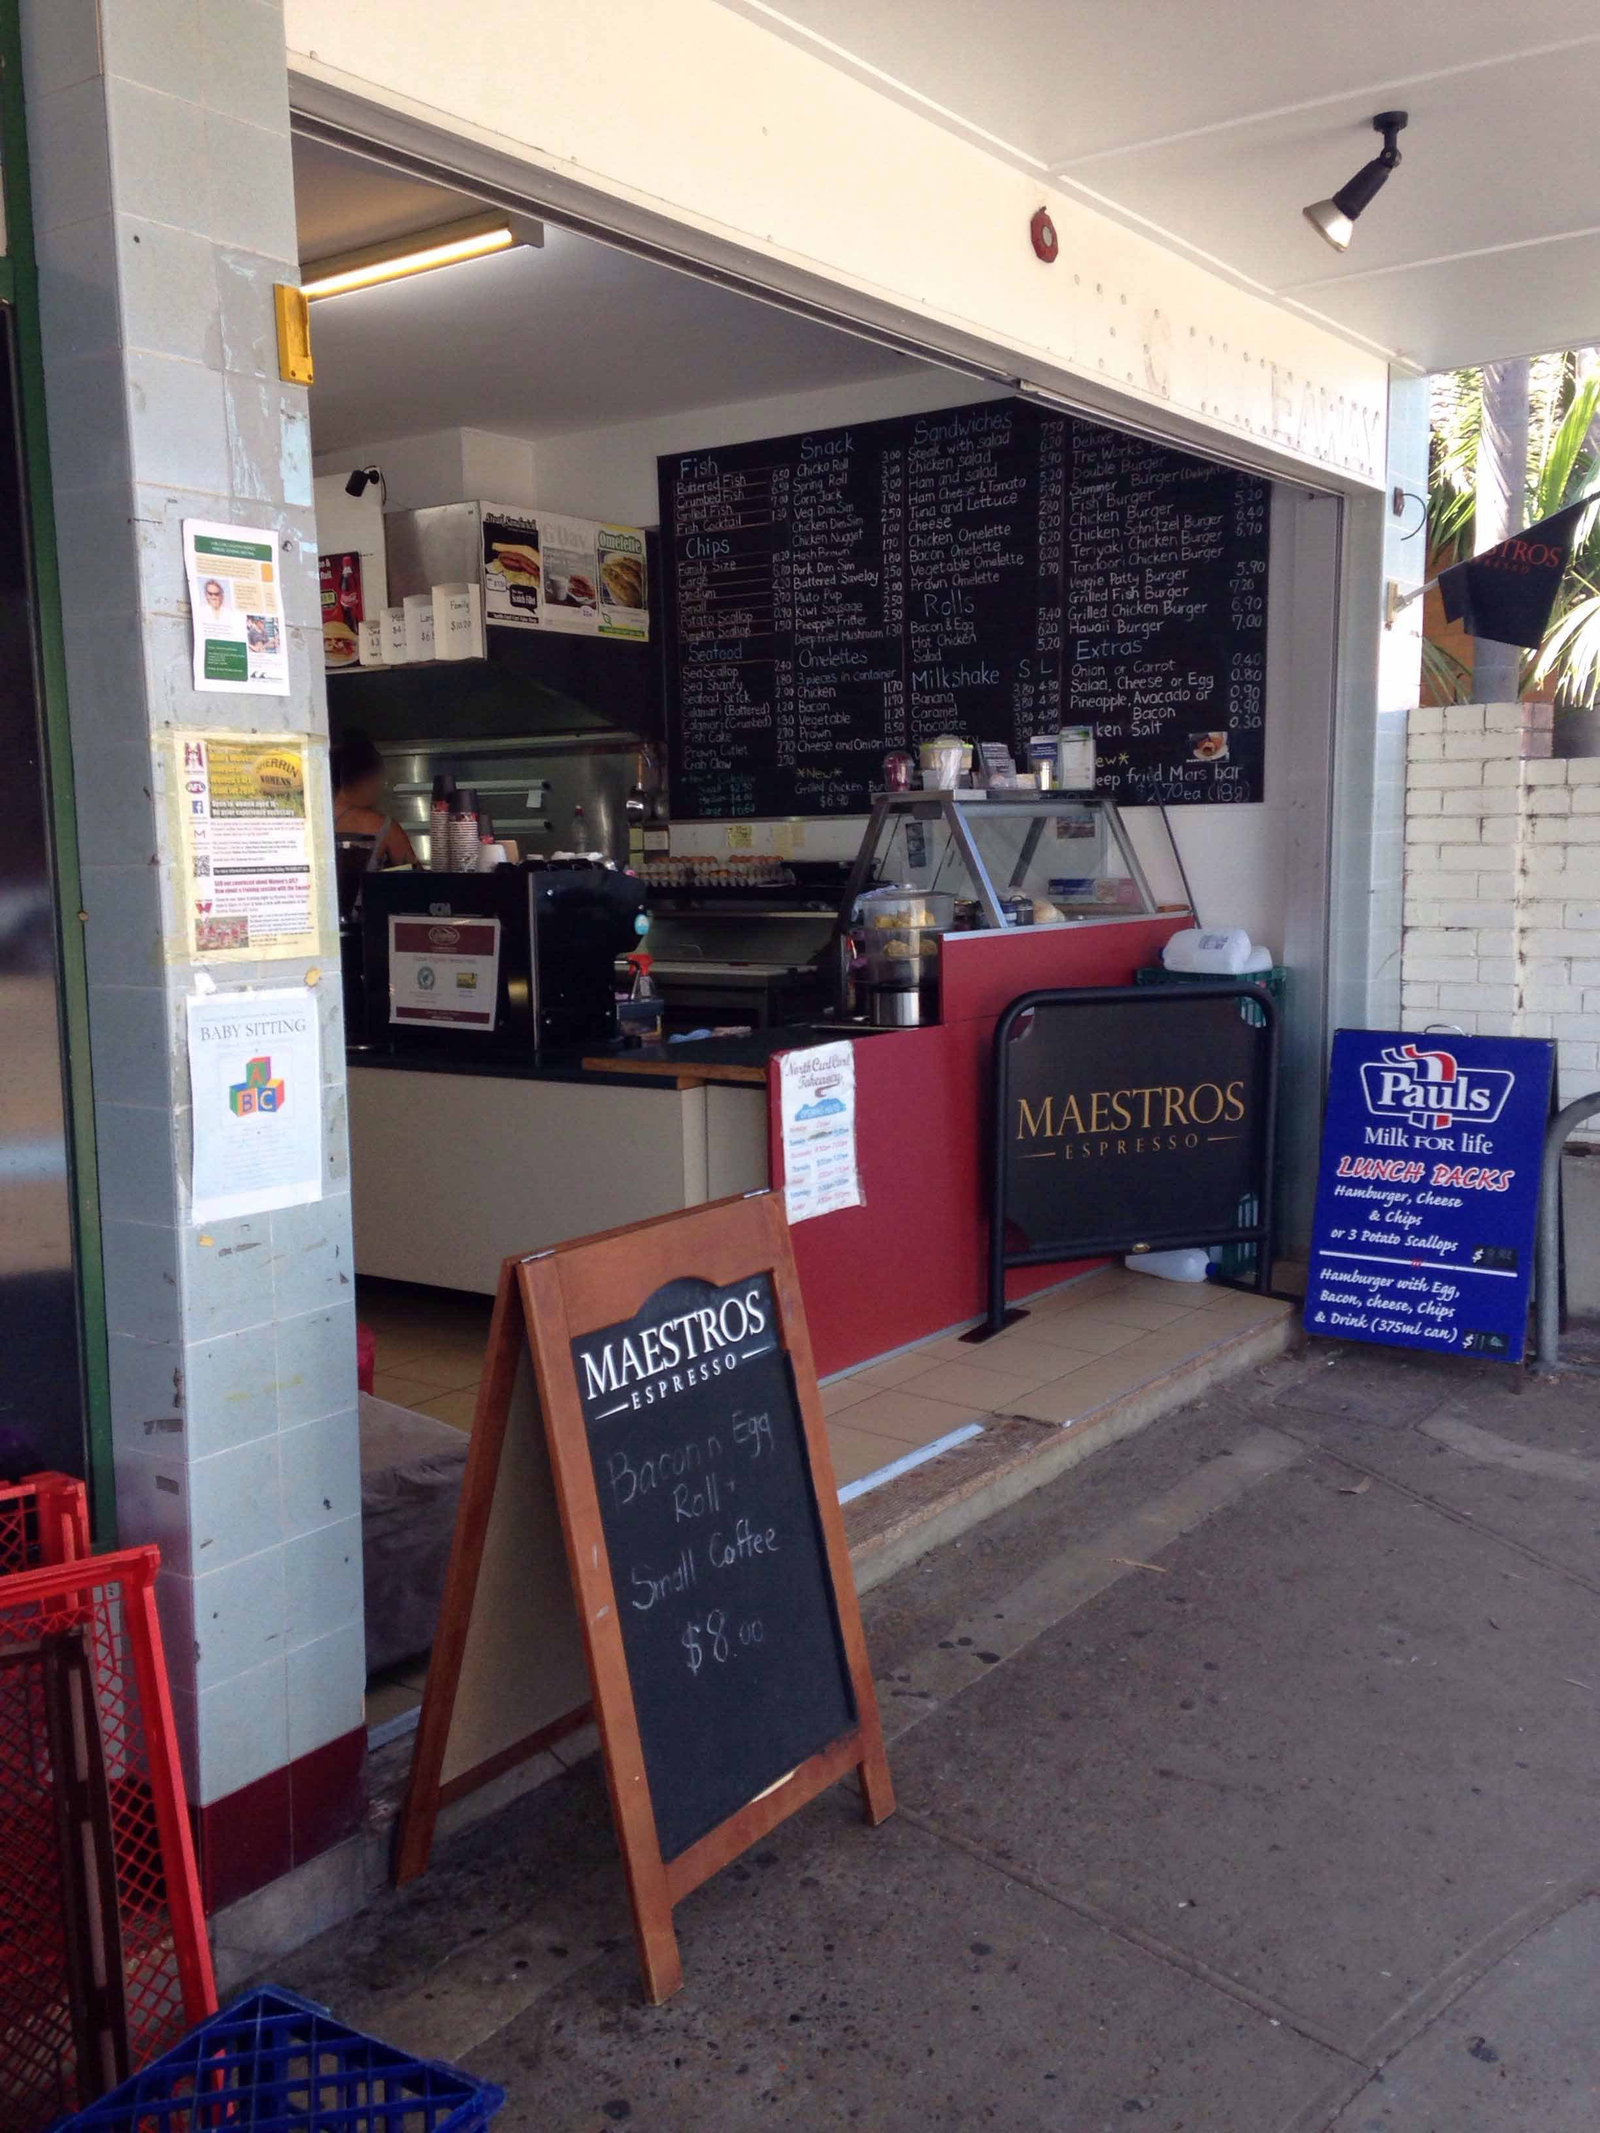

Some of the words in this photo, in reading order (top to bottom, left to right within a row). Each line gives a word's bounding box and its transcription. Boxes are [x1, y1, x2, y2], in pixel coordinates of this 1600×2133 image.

[913, 408, 1014, 445] Sandwiches
[801, 432, 855, 460] Snack
[907, 440, 941, 461] Steak
[947, 439, 974, 454] with
[977, 432, 1010, 449] salad
[1072, 450, 1097, 464] The
[1101, 441, 1144, 460] Works
[680, 456, 719, 479] Fish
[908, 457, 954, 474] Chicken
[957, 450, 991, 467] salad
[1072, 462, 1115, 480] Double
[1121, 456, 1166, 473] Burger
[829, 472, 848, 487] Roll
[909, 476, 934, 491] Ham
[938, 469, 960, 486] and
[965, 462, 998, 482] salad
[1070, 480, 1118, 497] Summer
[1131, 469, 1182, 489] Burger
[793, 493, 816, 506] Corn
[817, 489, 842, 502] Jack
[909, 492, 935, 505] Ham
[939, 485, 975, 500] Cheese
[989, 475, 1026, 492] Tomato
[1071, 497, 1100, 513] Fish
[1107, 490, 1156, 508] Burger
[909, 506, 936, 519] Tuna
[941, 499, 962, 513] and
[967, 491, 1017, 511] Lettuce
[1069, 510, 1119, 526] Chicken
[1127, 503, 1174, 523] Burger
[909, 517, 952, 532] Cheese
[909, 532, 953, 547] Chicken
[958, 524, 1012, 542] Omelette
[1069, 527, 1120, 542] Chicken
[1124, 515, 1180, 536] Schnitzel
[1184, 514, 1224, 531] Burger
[686, 537, 730, 559] Chips
[909, 550, 945, 562] Bacon
[951, 541, 1002, 557] Omelette
[1071, 541, 1124, 560] Teriyaki
[1128, 533, 1178, 551] Chicken
[1181, 530, 1222, 548] Burger
[911, 558, 970, 580] Vegetable
[974, 552, 1024, 569] Omelette
[1070, 556, 1126, 574] Tandoori
[1128, 550, 1178, 567] Chicken
[1181, 547, 1225, 564] Burger
[841, 568, 879, 587] Saveloy
[911, 578, 948, 591] Prawn
[952, 572, 1000, 586] Omelette
[1070, 575, 1105, 594] Veggie
[1109, 571, 1140, 589] Patty
[1145, 568, 1189, 587] Burger
[1236, 561, 1265, 576] 5.90
[824, 589, 842, 604] Pup
[924, 589, 975, 617] Rolls
[1068, 590, 1108, 604] Grilled
[1112, 586, 1139, 600] Fish
[1144, 585, 1190, 604] Burger
[1068, 604, 1107, 621] Grilled
[1111, 601, 1159, 618] Chicken
[1163, 599, 1208, 622] Burger
[1231, 596, 1262, 612] 6.90
[911, 621, 943, 634] Bacon
[954, 617, 974, 631] Egg
[1069, 619, 1110, 635] Hawaii
[1117, 618, 1165, 640] Burger
[1232, 615, 1262, 631] 7.00
[688, 640, 742, 662] Seafood
[912, 636, 932, 649] Hot
[937, 633, 977, 647] Chicken
[1076, 639, 1143, 661] Extras
[800, 646, 868, 668] Omelettes
[1071, 663, 1106, 677] Onion
[1114, 665, 1126, 674] or
[1133, 659, 1177, 674] Carrot
[1232, 652, 1261, 666] 0.40
[841, 672, 850, 681] in
[853, 669, 896, 681] container
[912, 660, 1000, 691] Milkshake
[1019, 659, 1030, 678] S
[1040, 658, 1053, 674] L
[1070, 679, 1111, 693] Salad,
[1117, 674, 1163, 690] Cheese
[1170, 677, 1183, 687] or
[1187, 672, 1215, 690] Egg
[1231, 668, 1262, 681] 0.80
[799, 700, 830, 713] Bacon
[911, 692, 954, 705] Banana
[1070, 694, 1131, 713] Pineapple,
[1133, 690, 1190, 705] Avocado
[1196, 689, 1211, 701] or
[1230, 685, 1260, 699] 0.90
[911, 703, 957, 719] Caramel
[1132, 706, 1176, 721] Bacon
[1229, 701, 1260, 714] 0.90
[799, 727, 831, 739] Prawn
[911, 719, 967, 733] Chocolate
[1131, 721, 1163, 737] Salt
[1229, 715, 1262, 729] 0.30
[797, 741, 833, 753] Cheese
[854, 738, 883, 751] Onion
[200, 1024, 242, 1042] BABY
[246, 1018, 307, 1038] SITTING
[251, 1065, 263, 1083] A
[242, 1093, 253, 1113] B
[259, 1091, 273, 1110] C
[1377, 1071, 1491, 1112] Pauls
[1016, 1080, 1245, 1140] MAESTROS
[1065, 1133, 1198, 1160] ESPRESSO
[1364, 1127, 1410, 1147] Milk
[1414, 1135, 1455, 1151] FOR
[1461, 1132, 1493, 1155] life
[1336, 1155, 1426, 1184] LUNCH
[1430, 1163, 1515, 1192] PACKS
[1334, 1185, 1412, 1207] Hamburger,
[1416, 1192, 1463, 1208] Cheese
[1369, 1210, 1381, 1221] &
[1385, 1211, 1423, 1230] Chips
[1331, 1228, 1346, 1239] or
[1348, 1229, 1357, 1240] 3
[1361, 1230, 1401, 1245] Potato
[1404, 1236, 1459, 1257] Scallops
[1320, 1268, 1395, 1292] Hamburger
[1397, 1277, 1430, 1293] with
[1431, 1281, 1460, 1300] Egg,
[1320, 1290, 1363, 1308] Bacon,
[1366, 1294, 1414, 1314] cheese,
[1417, 1302, 1456, 1322] Chips
[1314, 1311, 1327, 1323] &
[1331, 1312, 1369, 1329] Drink
[1370, 1317, 1422, 1335] (375ml
[1424, 1326, 1459, 1343] can)
[580, 1290, 766, 1400] MAESTROS
[632, 1353, 736, 1410] ESPRESSO
[609, 1442, 701, 1504] Bacon
[732, 1411, 774, 1457] Egg
[673, 1472, 720, 1524] Roll
[632, 1550, 696, 1610] Small
[709, 1519, 779, 1568] Coffee
